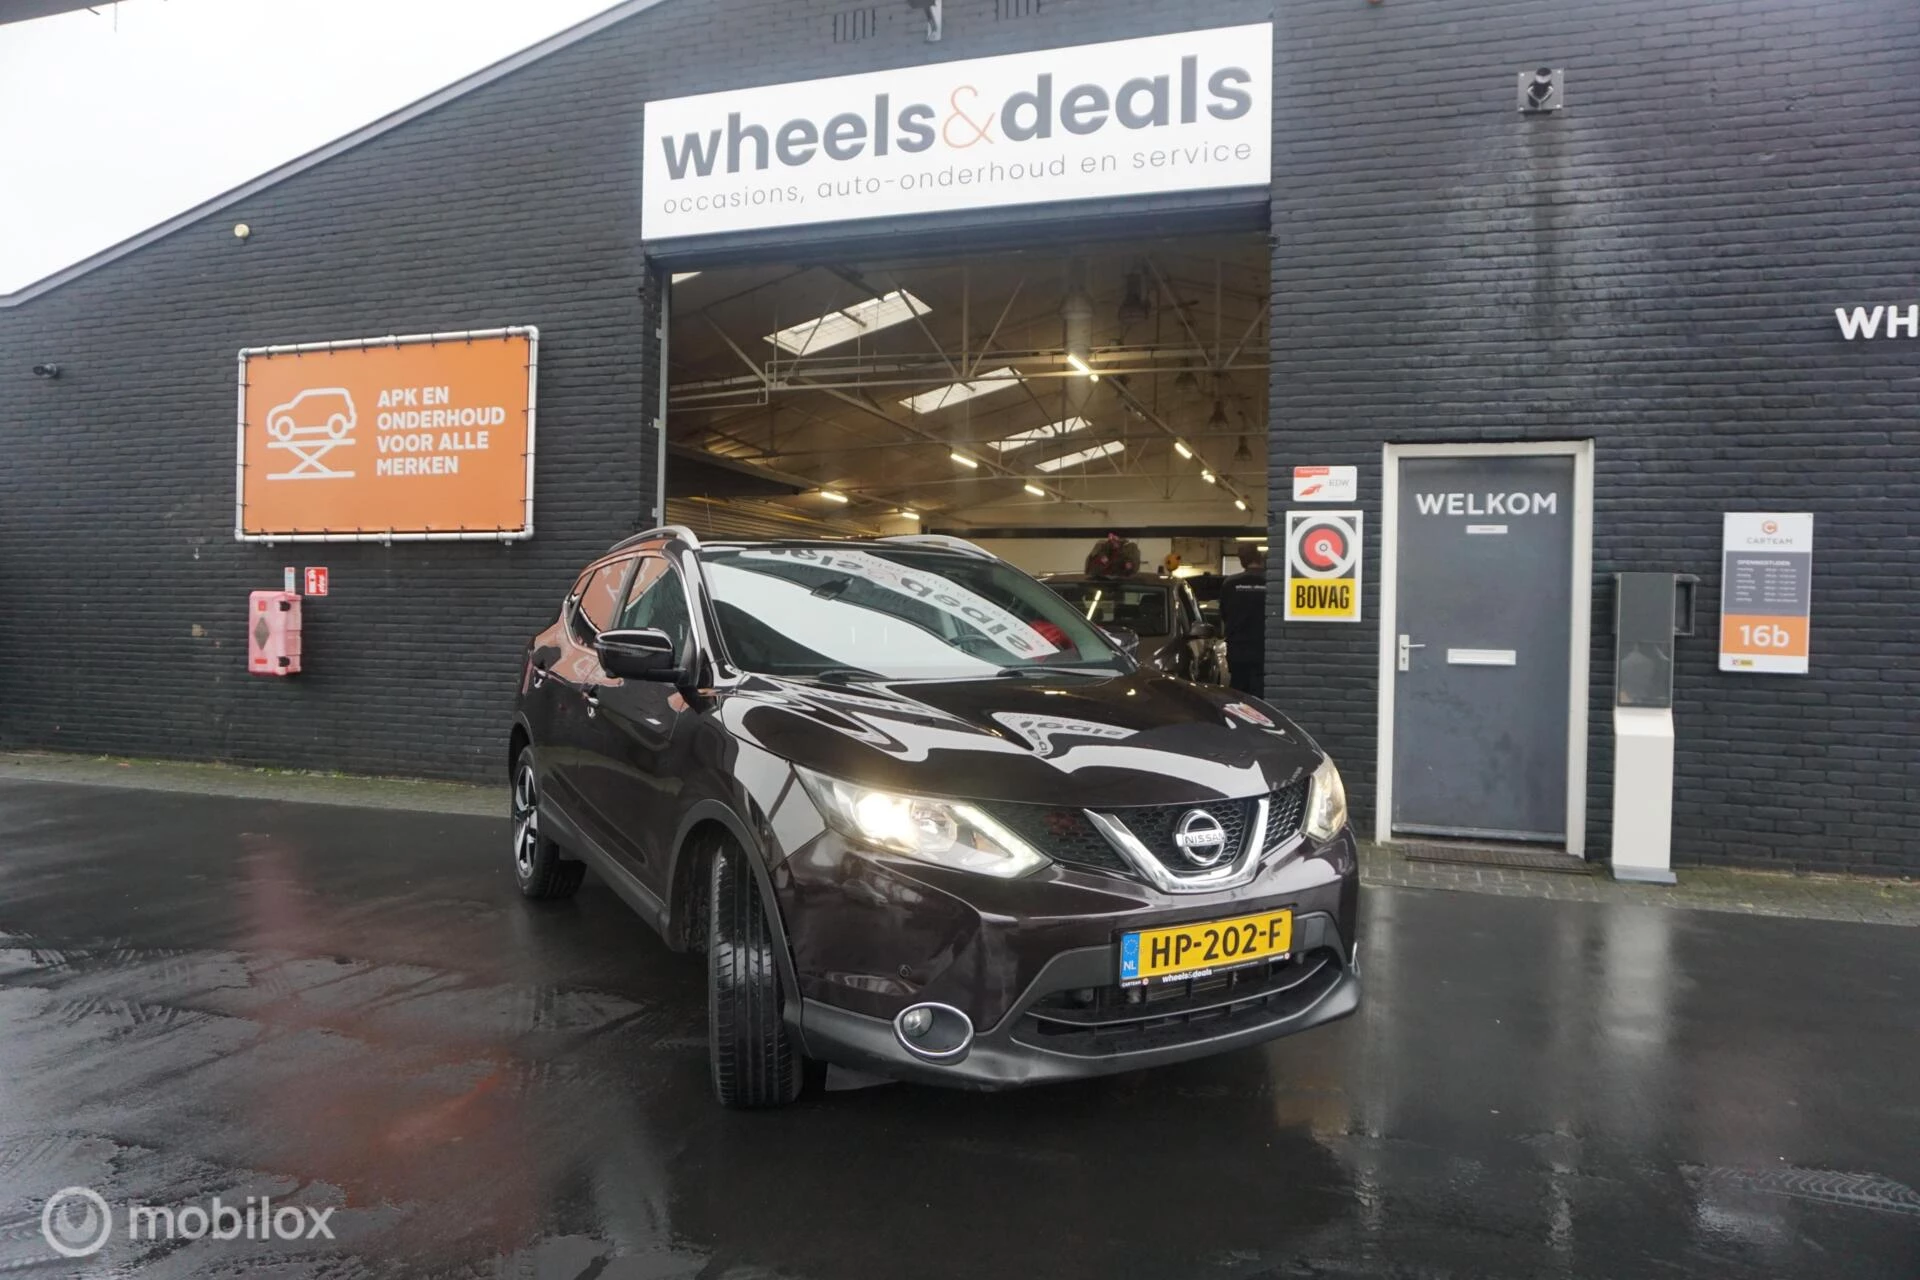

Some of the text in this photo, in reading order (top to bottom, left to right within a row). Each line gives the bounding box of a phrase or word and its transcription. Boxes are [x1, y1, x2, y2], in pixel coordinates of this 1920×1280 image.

[661, 54, 1253, 180] wheels&deals
[663, 139, 1252, 214] occasions, auto-onderhoud en service
[377, 386, 449, 408] APK EN
[377, 407, 505, 430] ONDERHOUD
[377, 431, 489, 453] VOOR ALLE
[376, 456, 459, 476] MERKEN
[1416, 492, 1558, 516] WELKOM
[1296, 584, 1350, 610] BOVAG
[1739, 625, 1789, 647] 16b
[1183, 831, 1226, 844] NISSAN
[1151, 918, 1282, 968] HP-202-F
[1123, 960, 1137, 971] NL
